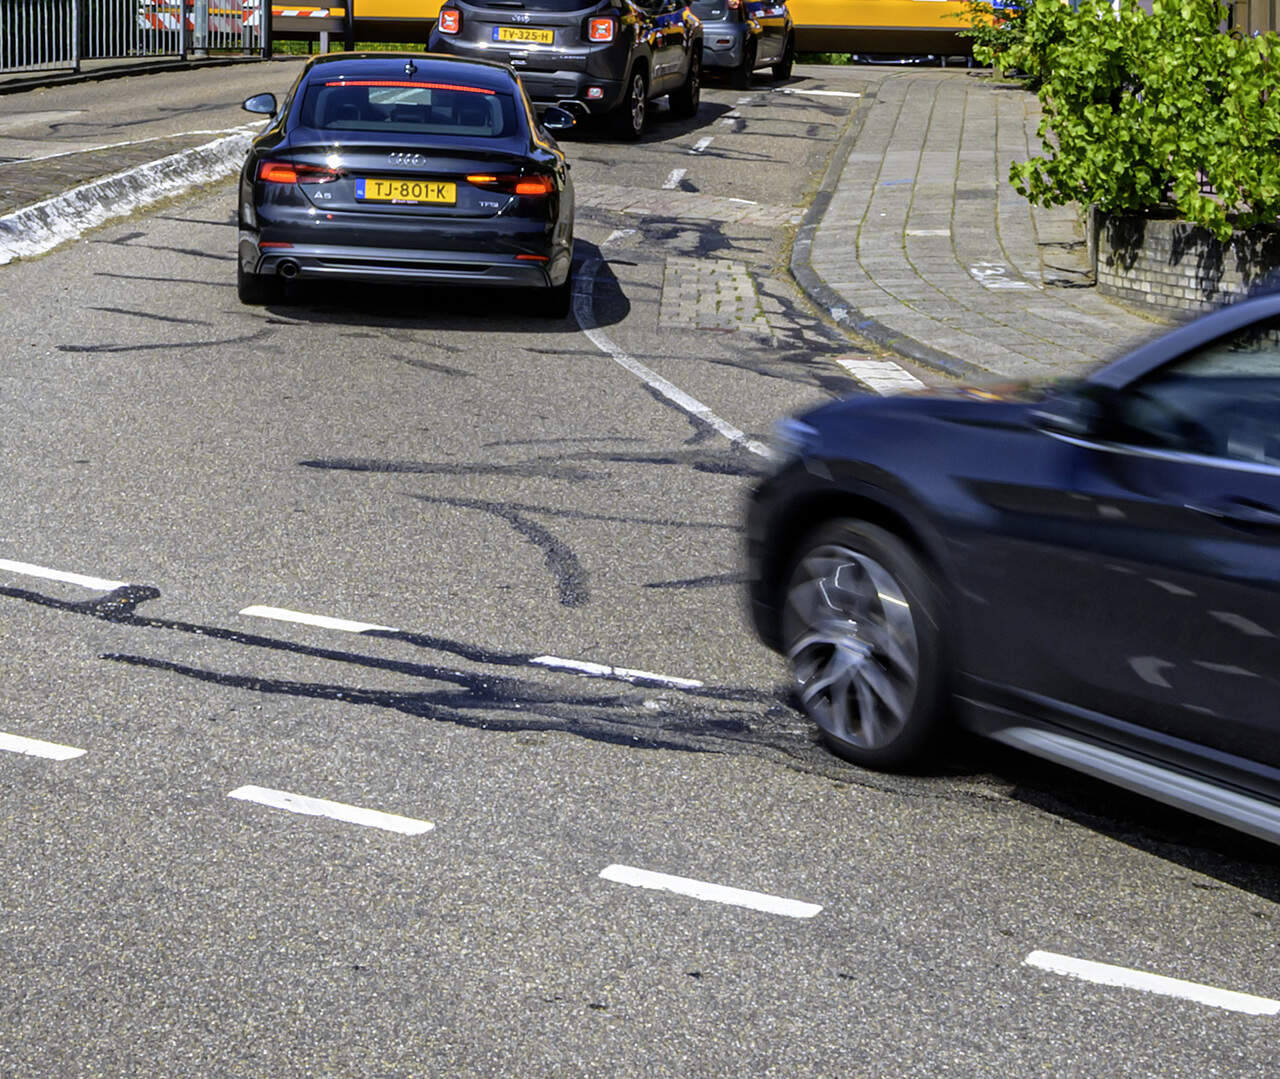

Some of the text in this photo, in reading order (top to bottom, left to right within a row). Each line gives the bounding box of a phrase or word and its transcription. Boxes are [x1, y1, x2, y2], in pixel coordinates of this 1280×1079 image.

[502, 29, 549, 41] TV-325-H
[314, 191, 332, 199] A5
[375, 182, 446, 199] TJ-801-K
